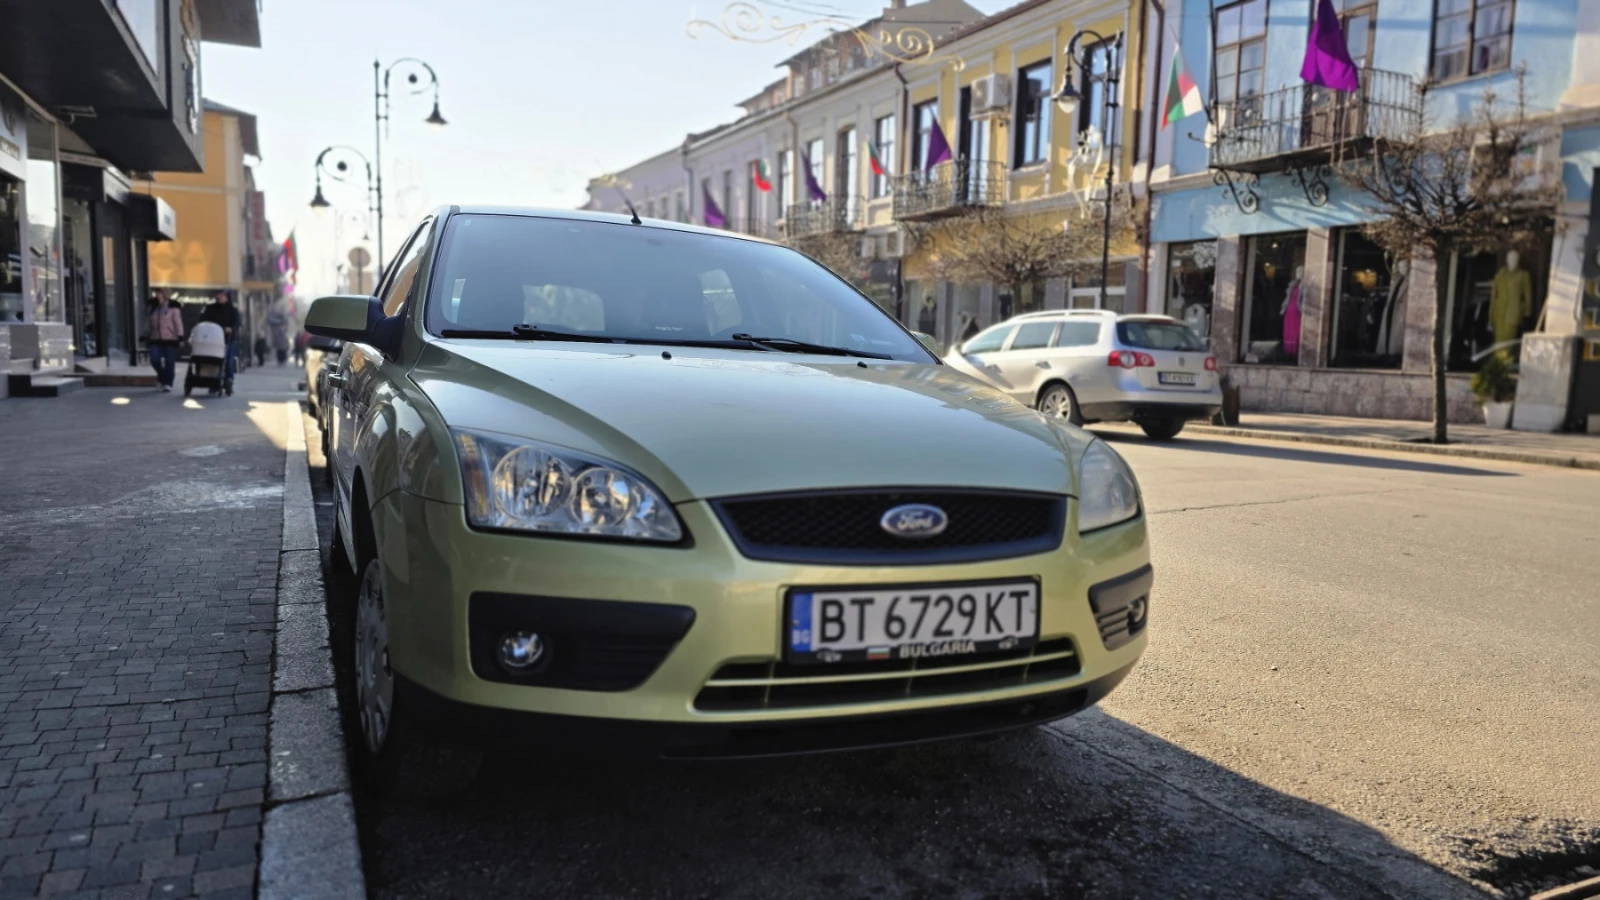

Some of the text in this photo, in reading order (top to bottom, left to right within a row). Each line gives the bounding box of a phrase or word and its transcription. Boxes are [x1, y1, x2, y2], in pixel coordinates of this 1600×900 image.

[896, 510, 934, 530] Ford
[819, 590, 1030, 644] BT 6729 KT
[791, 629, 810, 645] BG
[899, 640, 976, 658] BULGARIA
